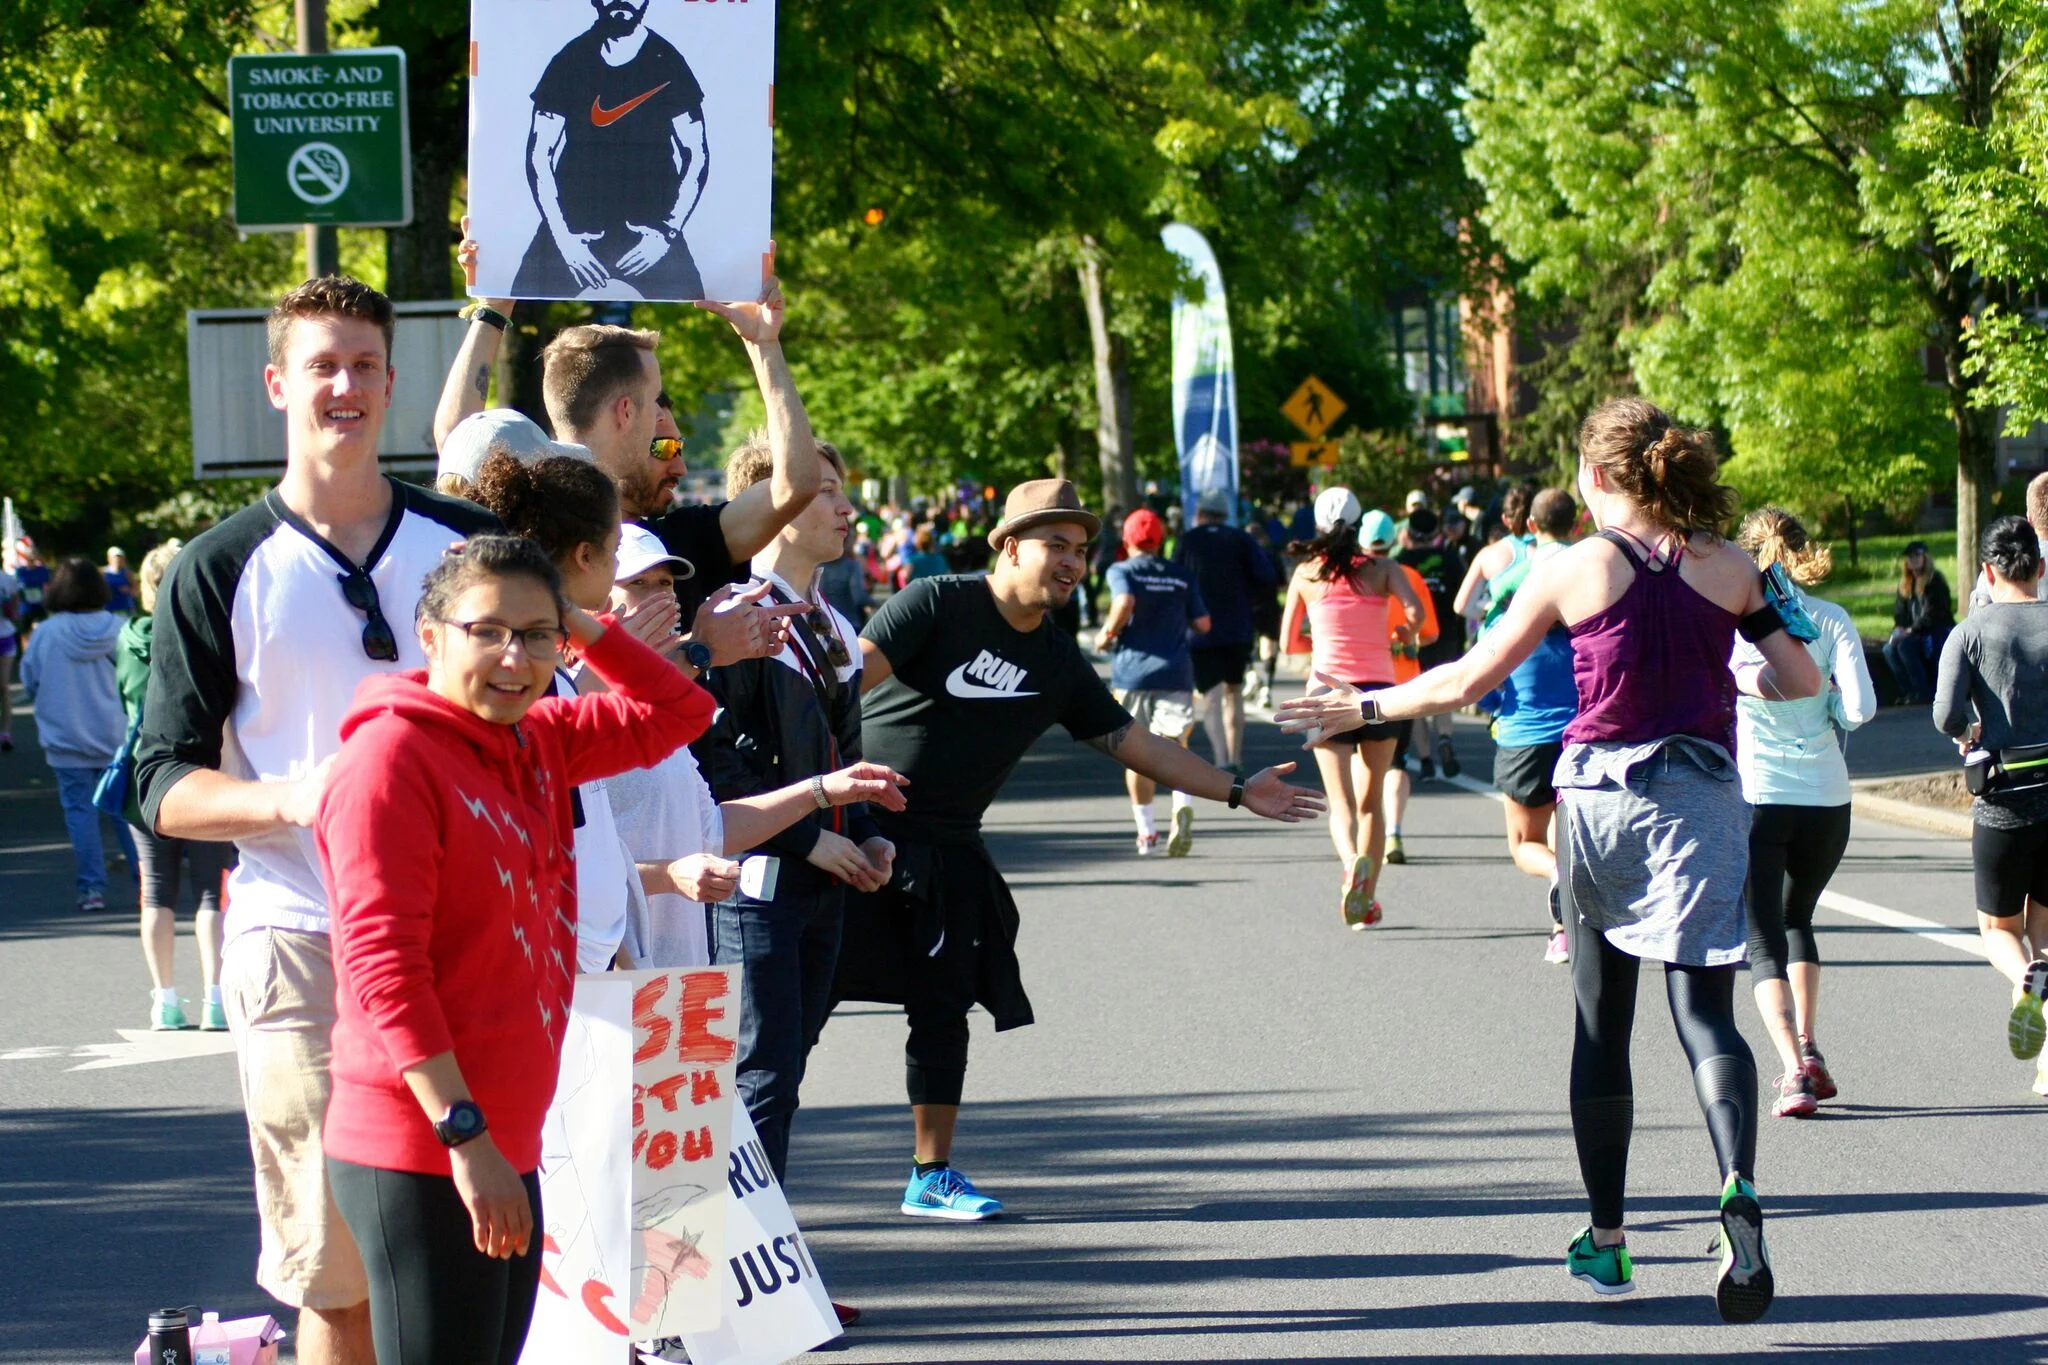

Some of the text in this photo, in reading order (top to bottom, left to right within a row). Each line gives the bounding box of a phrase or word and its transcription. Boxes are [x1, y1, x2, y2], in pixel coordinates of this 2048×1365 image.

[249, 66, 383, 85] SMOKE- AND
[240, 91, 394, 110] TOBACCO-FREE
[254, 116, 381, 134] UNIVERSITY
[966, 649, 1028, 692] RUN
[729, 1232, 813, 1307] JUST
